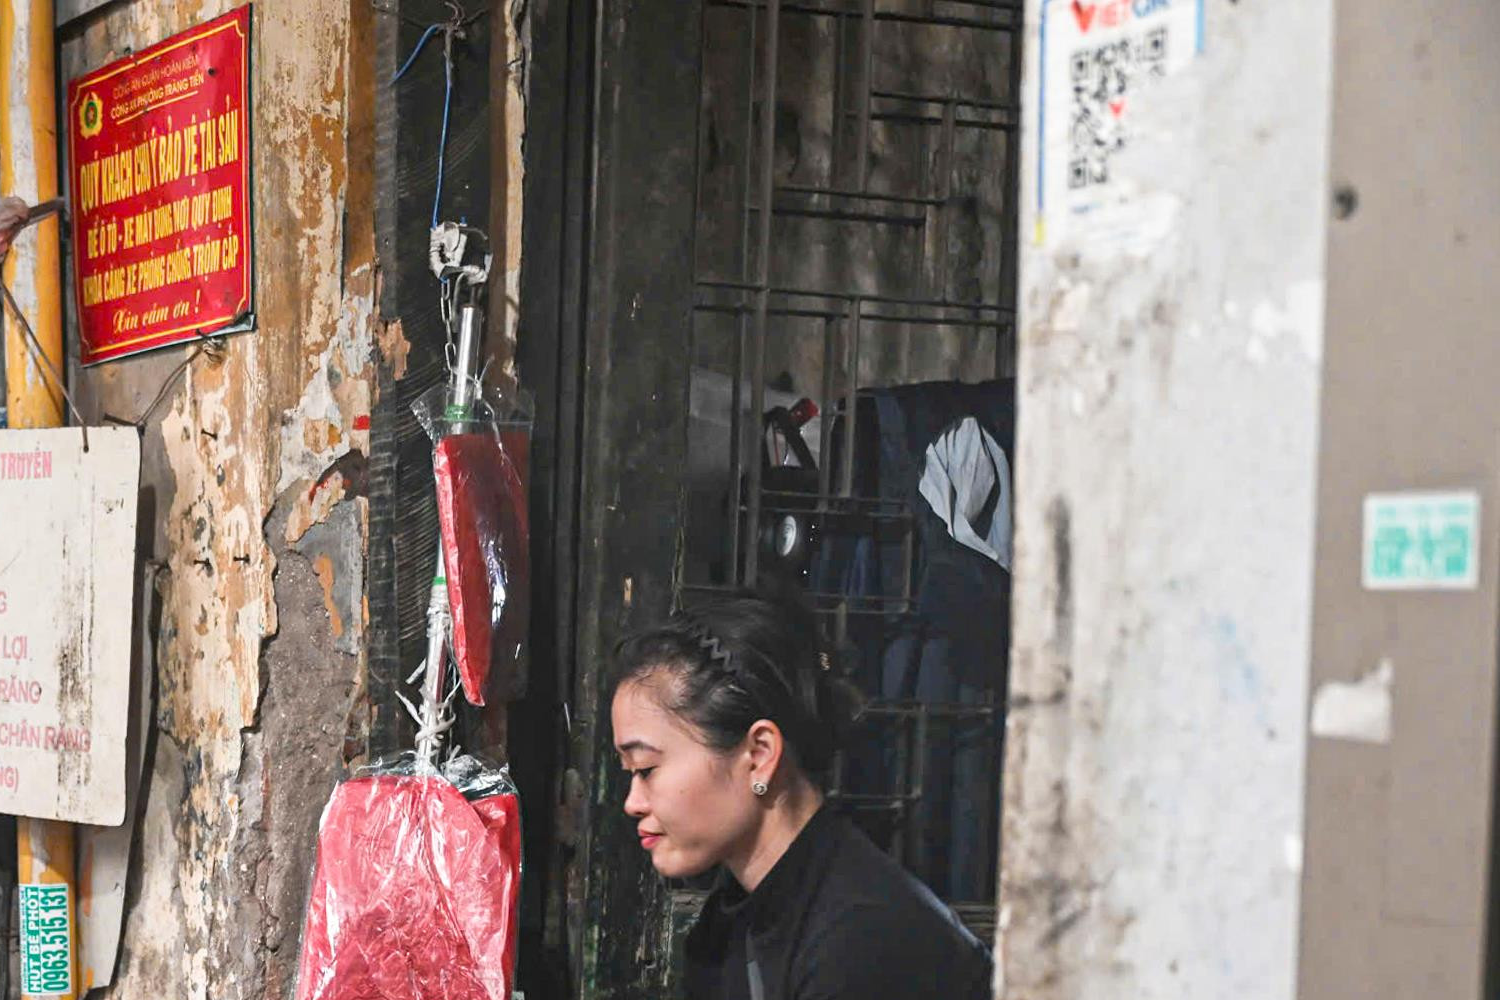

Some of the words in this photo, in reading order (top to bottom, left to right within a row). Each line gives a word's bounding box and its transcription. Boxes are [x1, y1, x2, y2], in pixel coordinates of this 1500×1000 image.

[101, 143, 133, 204] KHÁCH
[158, 115, 182, 184] BẢO
[183, 114, 198, 187] VỆ
[199, 109, 216, 172] TÀI
[218, 94, 239, 167] SẢN
[135, 205, 153, 246] MÁY
[193, 235, 220, 282] TRỘM
[0, 442, 52, 480] TRUYỀN
[44, 722, 92, 753] RĂNG
[40, 887, 69, 991] 0963.515.131
